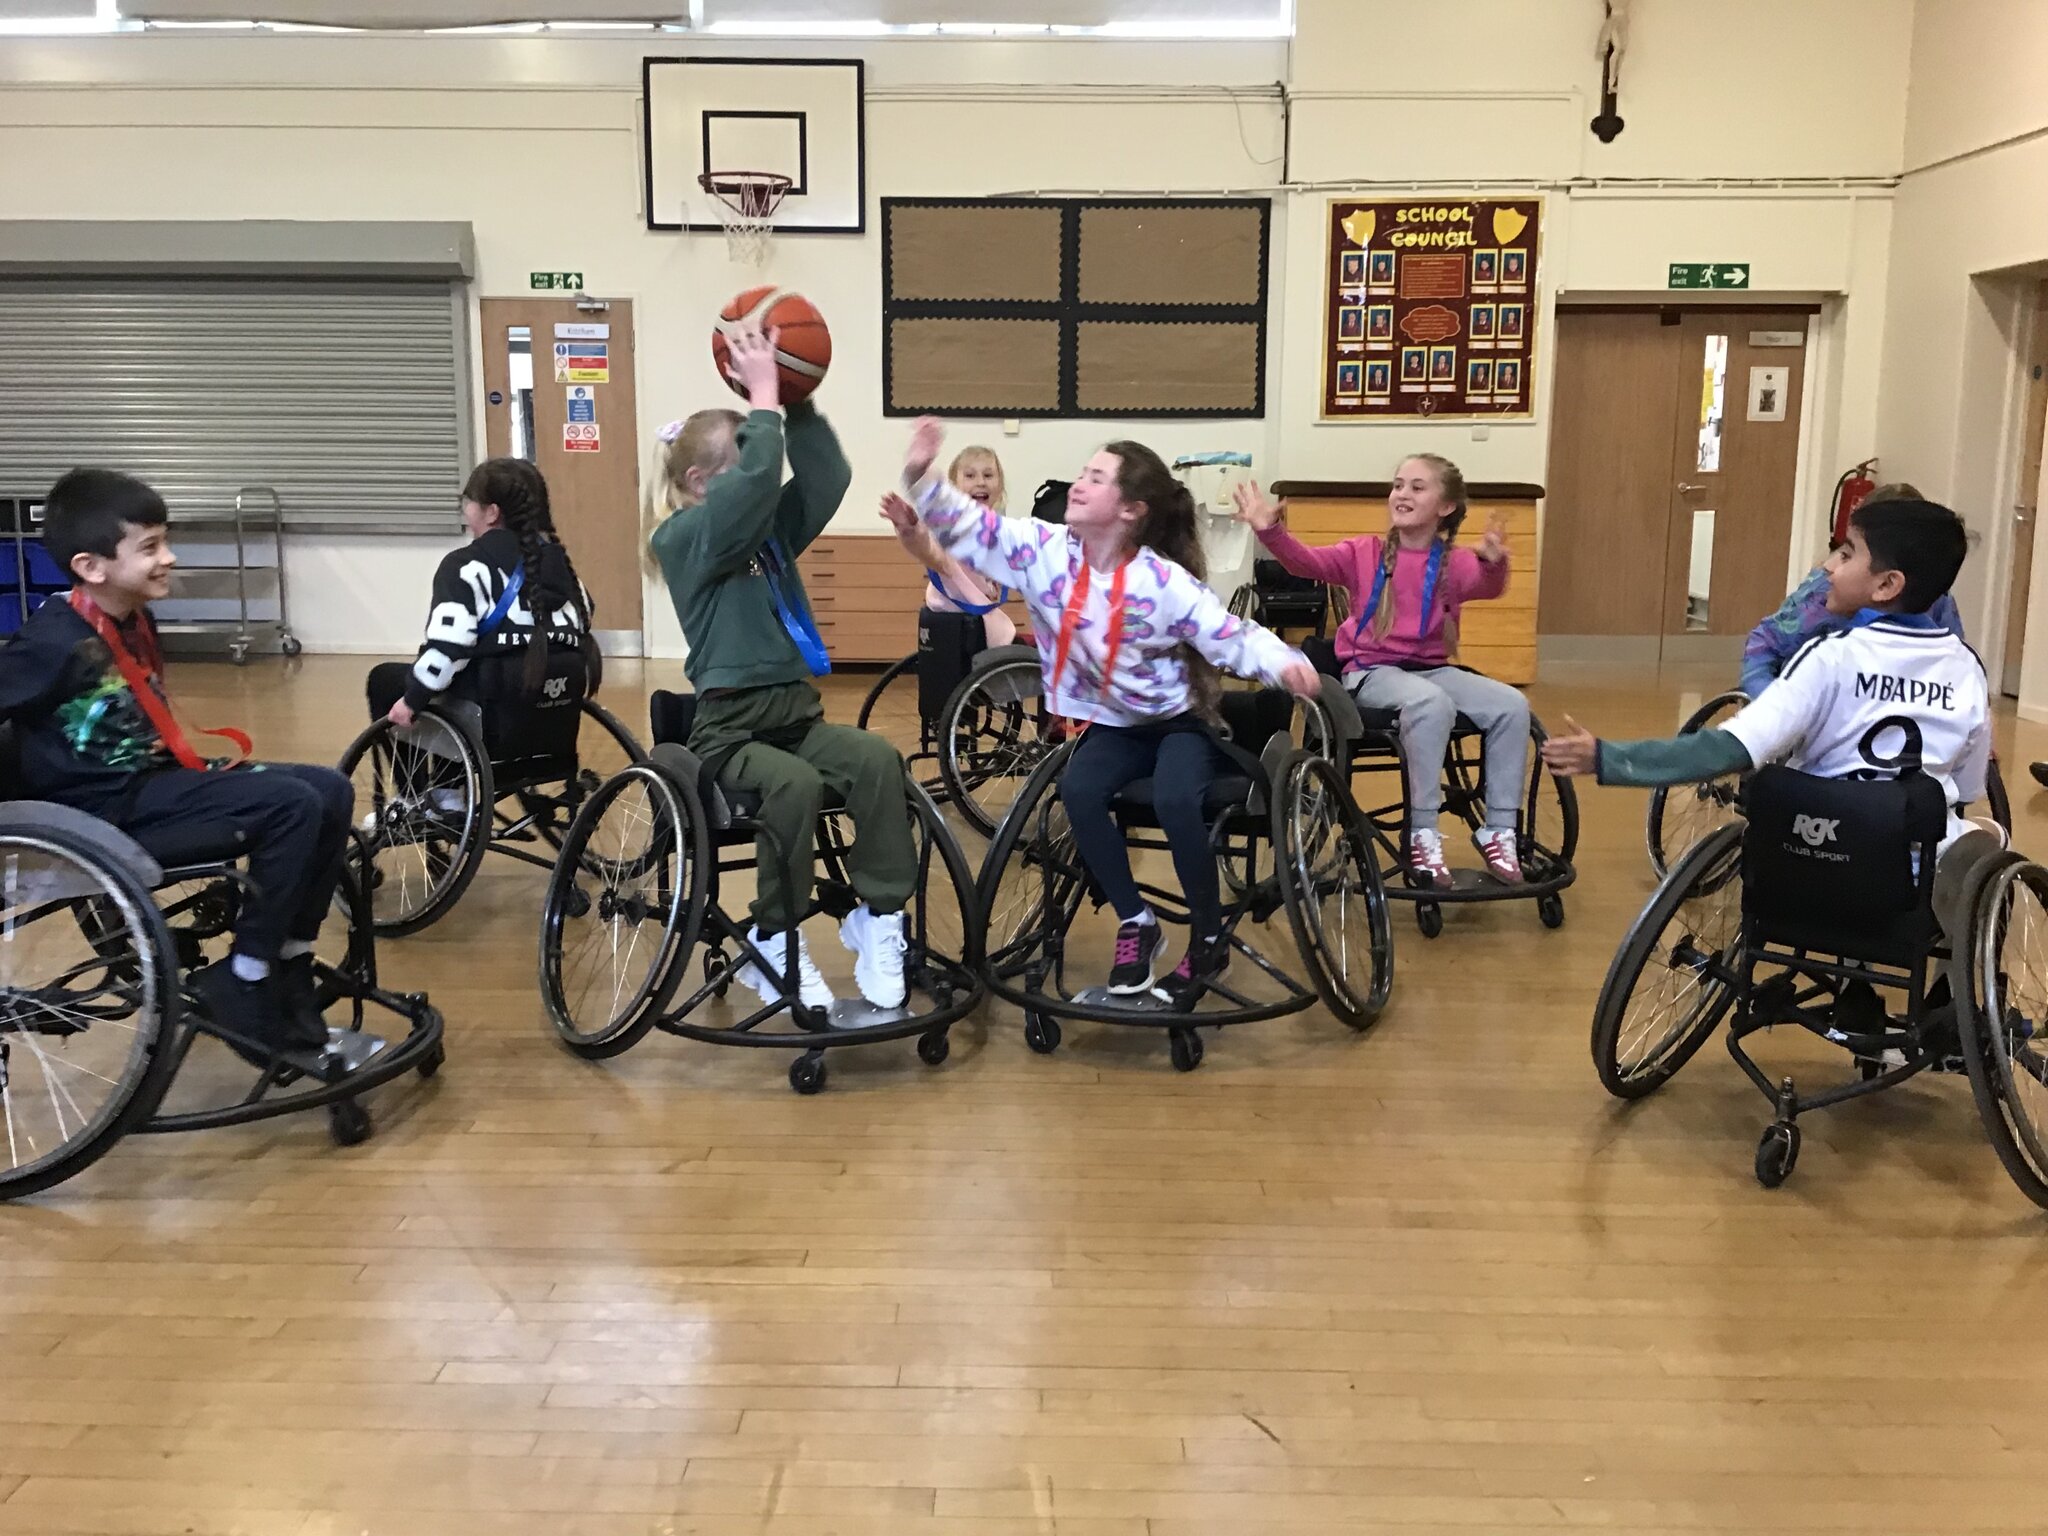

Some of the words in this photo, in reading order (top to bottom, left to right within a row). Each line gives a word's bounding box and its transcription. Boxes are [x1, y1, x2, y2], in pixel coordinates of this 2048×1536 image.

[1395, 206, 1473, 222] SCHOOL
[1391, 230, 1477, 247] COUNCIL
[1672, 266, 1688, 275] Fire
[1671, 277, 1687, 286] exit
[1854, 672, 1956, 712] MBAPPÉ
[1857, 714, 1924, 781] 9
[1783, 841, 1811, 857] CLUB
[1814, 850, 1851, 862] SPORT
